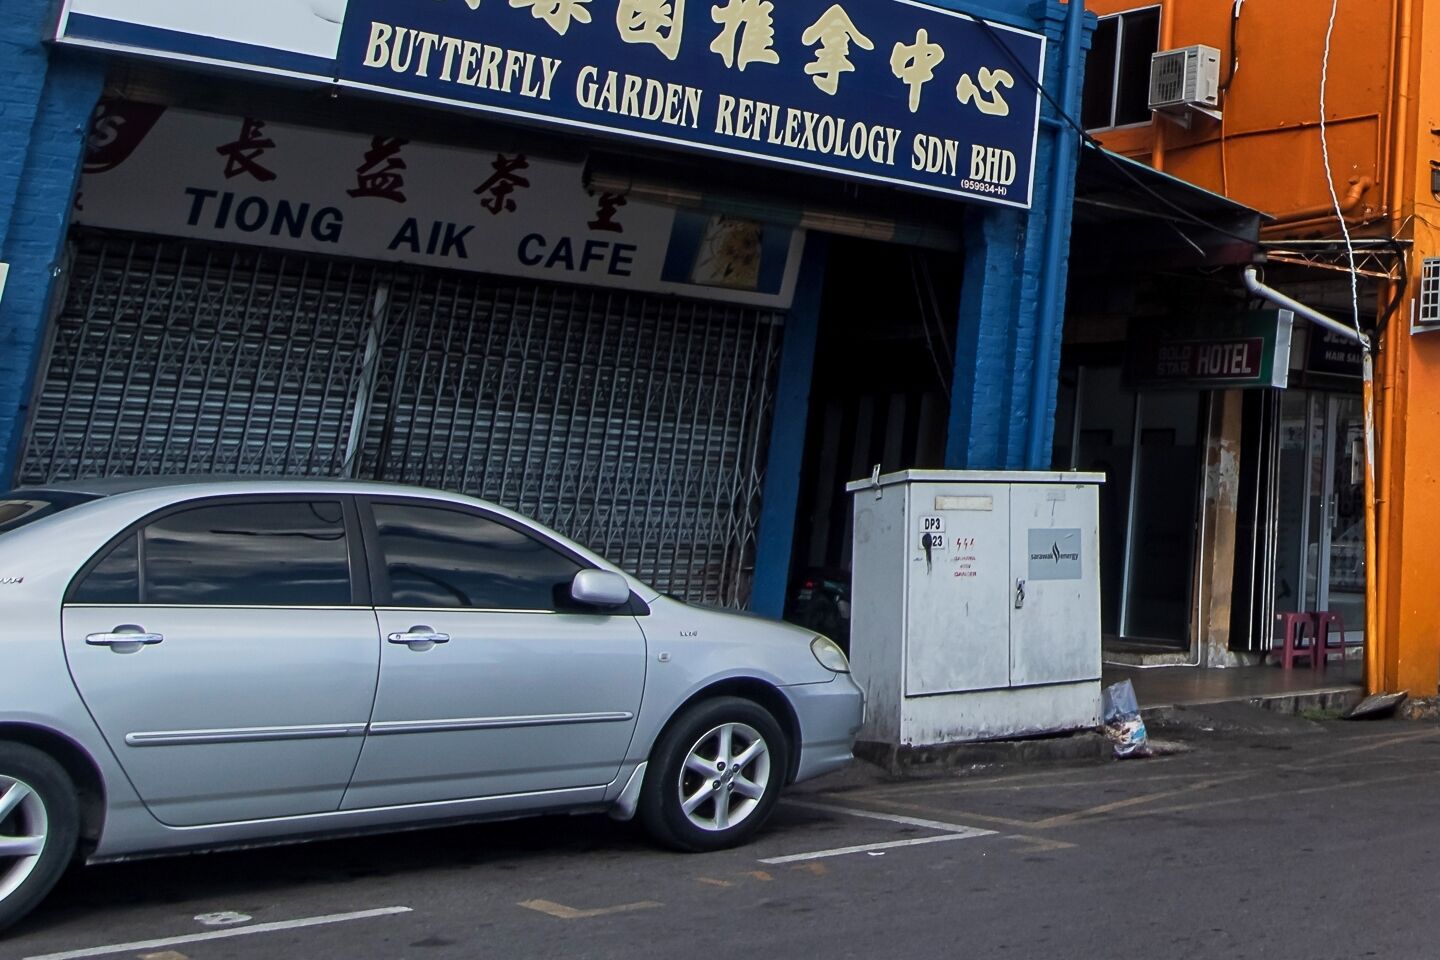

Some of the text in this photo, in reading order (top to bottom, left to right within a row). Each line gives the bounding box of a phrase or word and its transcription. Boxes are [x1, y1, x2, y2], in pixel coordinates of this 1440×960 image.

[363, 21, 1017, 187] BUTTERFLY GARDEN REFLEXOLOGY SDN BHD
[960, 178, 1007, 196] (959934-H)
[184, 187, 638, 277] TIONG AIK CAFE
[1158, 344, 1193, 361] GOLD
[1197, 343, 1252, 375] HOTEL
[1156, 361, 1191, 376] STAR
[924, 518, 941, 530] DP3
[928, 535, 943, 547] 23
[1030, 552, 1079, 561] sarawak energy
